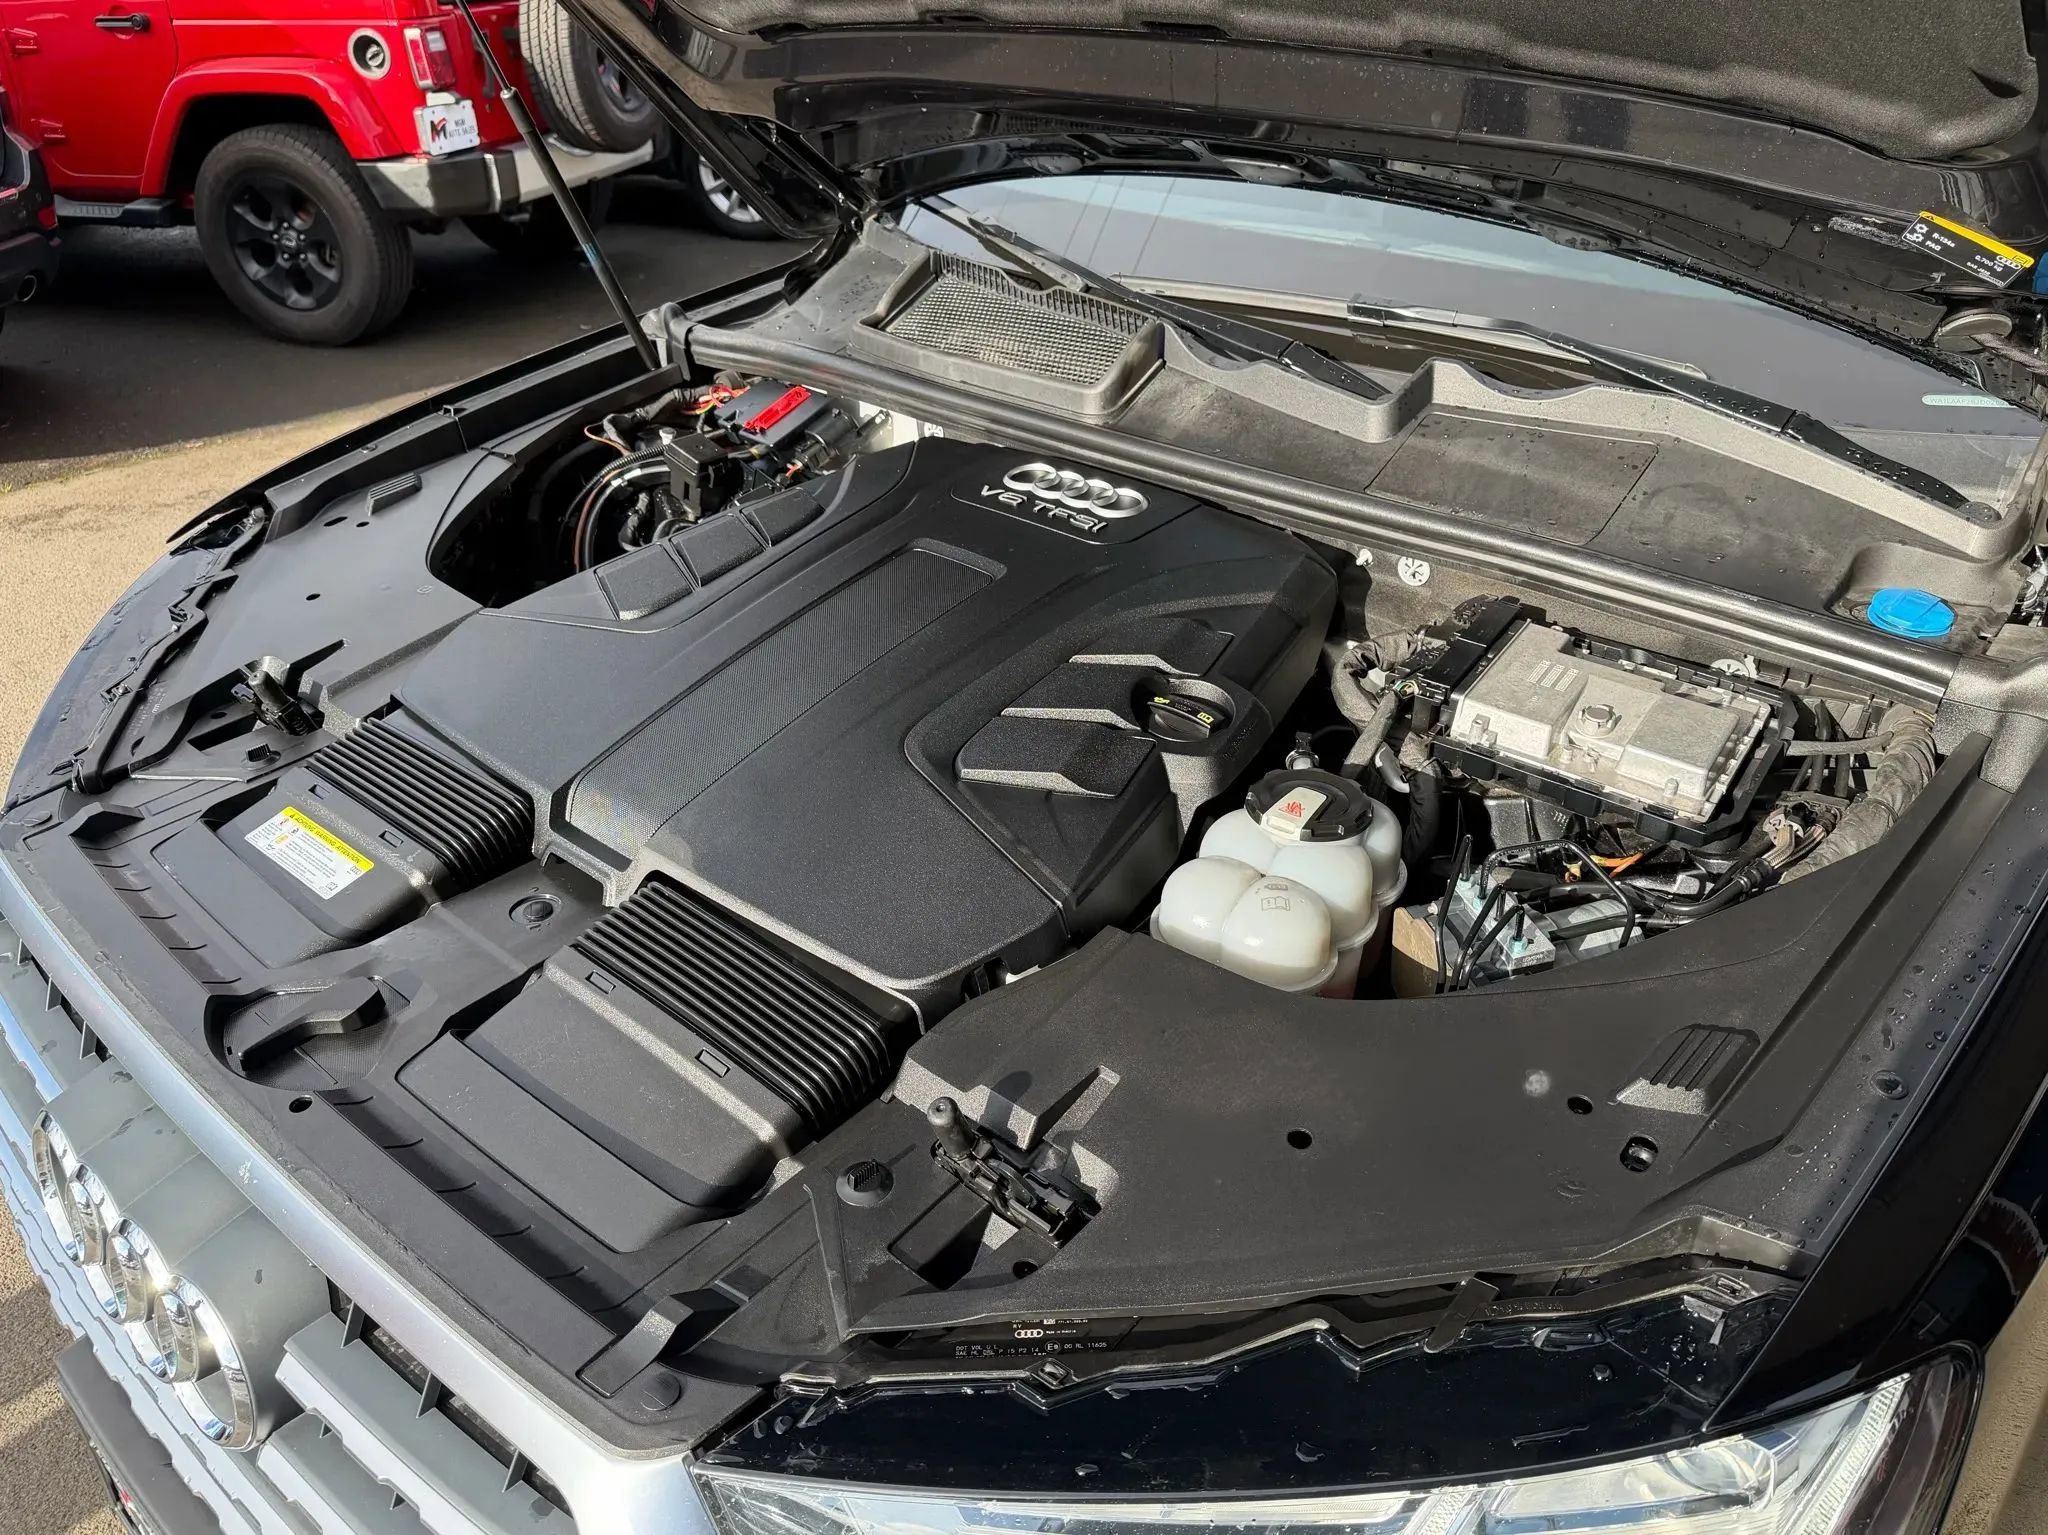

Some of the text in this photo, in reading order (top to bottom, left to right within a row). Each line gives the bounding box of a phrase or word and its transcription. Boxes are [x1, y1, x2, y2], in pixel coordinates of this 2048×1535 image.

[981, 485, 1108, 533] V6 TFSI
[315, 830, 337, 847] WARNING
[337, 845, 360, 864] ATTENTION
